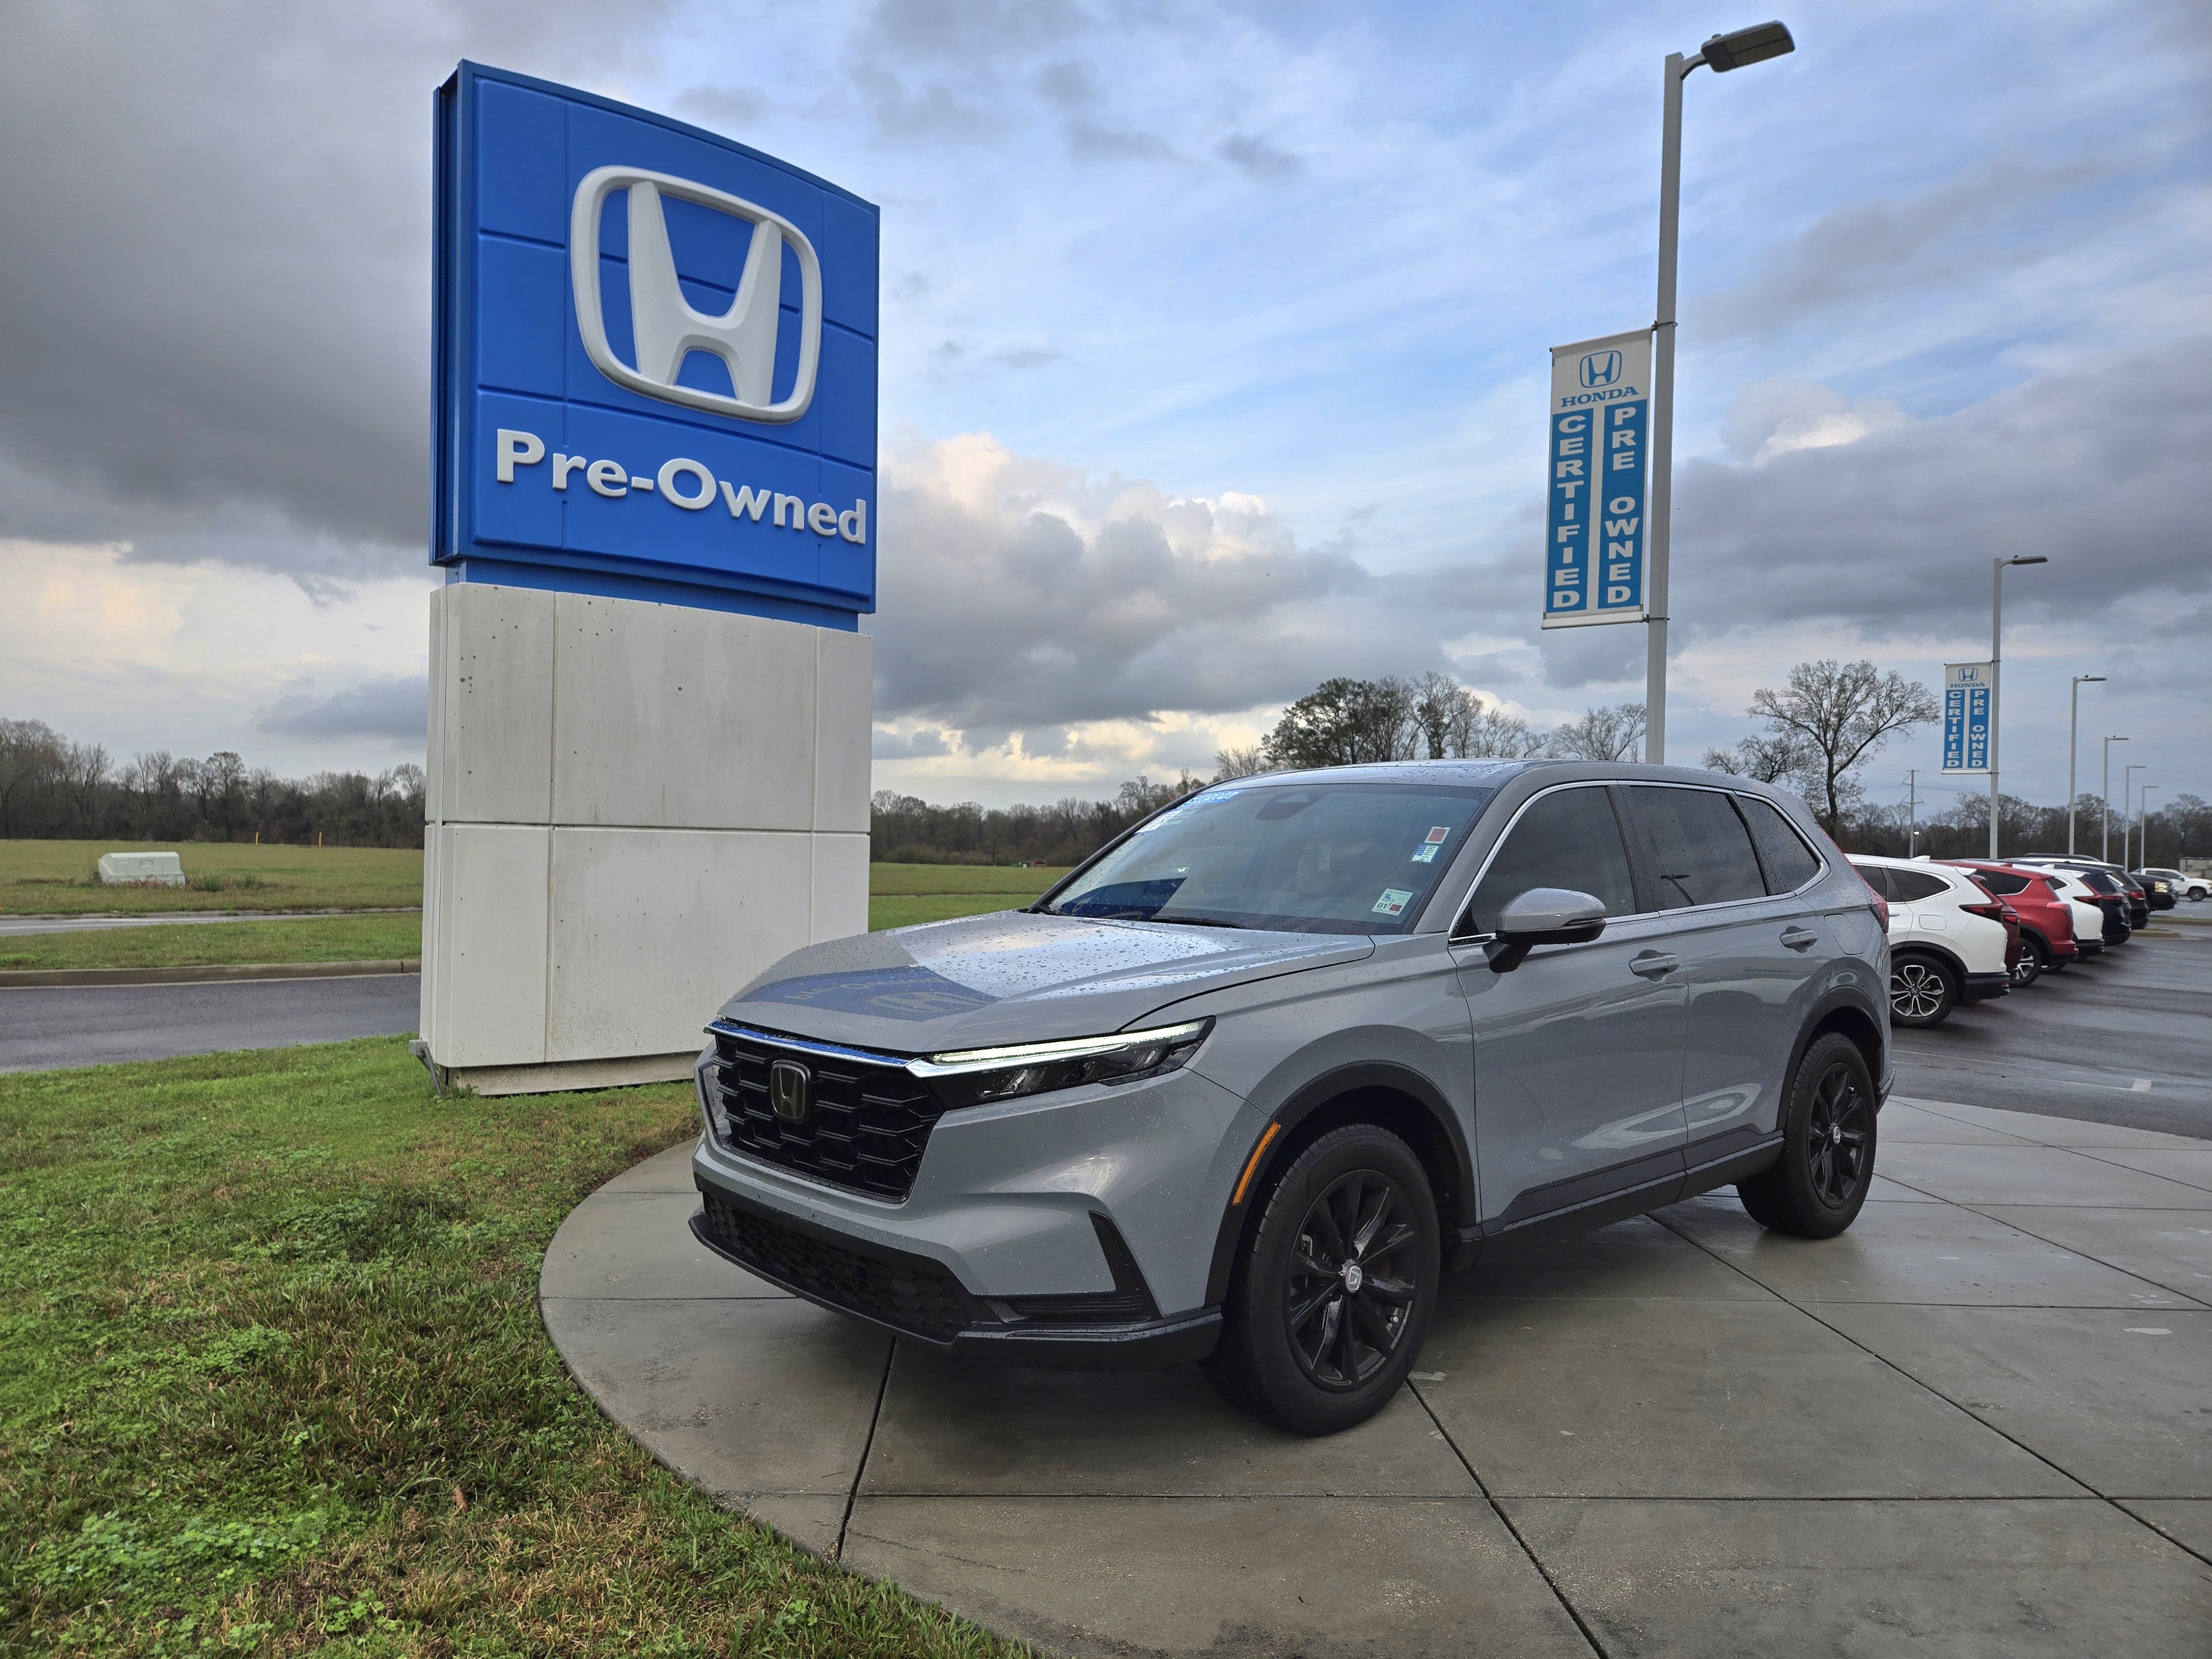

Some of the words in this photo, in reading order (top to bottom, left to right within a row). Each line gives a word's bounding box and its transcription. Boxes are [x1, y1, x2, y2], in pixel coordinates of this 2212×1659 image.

[1561, 385, 1639, 407] HONDA
[1612, 406, 1636, 471] PRE
[497, 429, 867, 545] Pre-Owned
[1553, 415, 1586, 608] CERTIFIED
[1605, 497, 1639, 604] OWNED
[1947, 691, 1962, 767] CERTIFIED
[1973, 690, 1985, 715] PRE
[1970, 725, 1986, 766] OWNED
